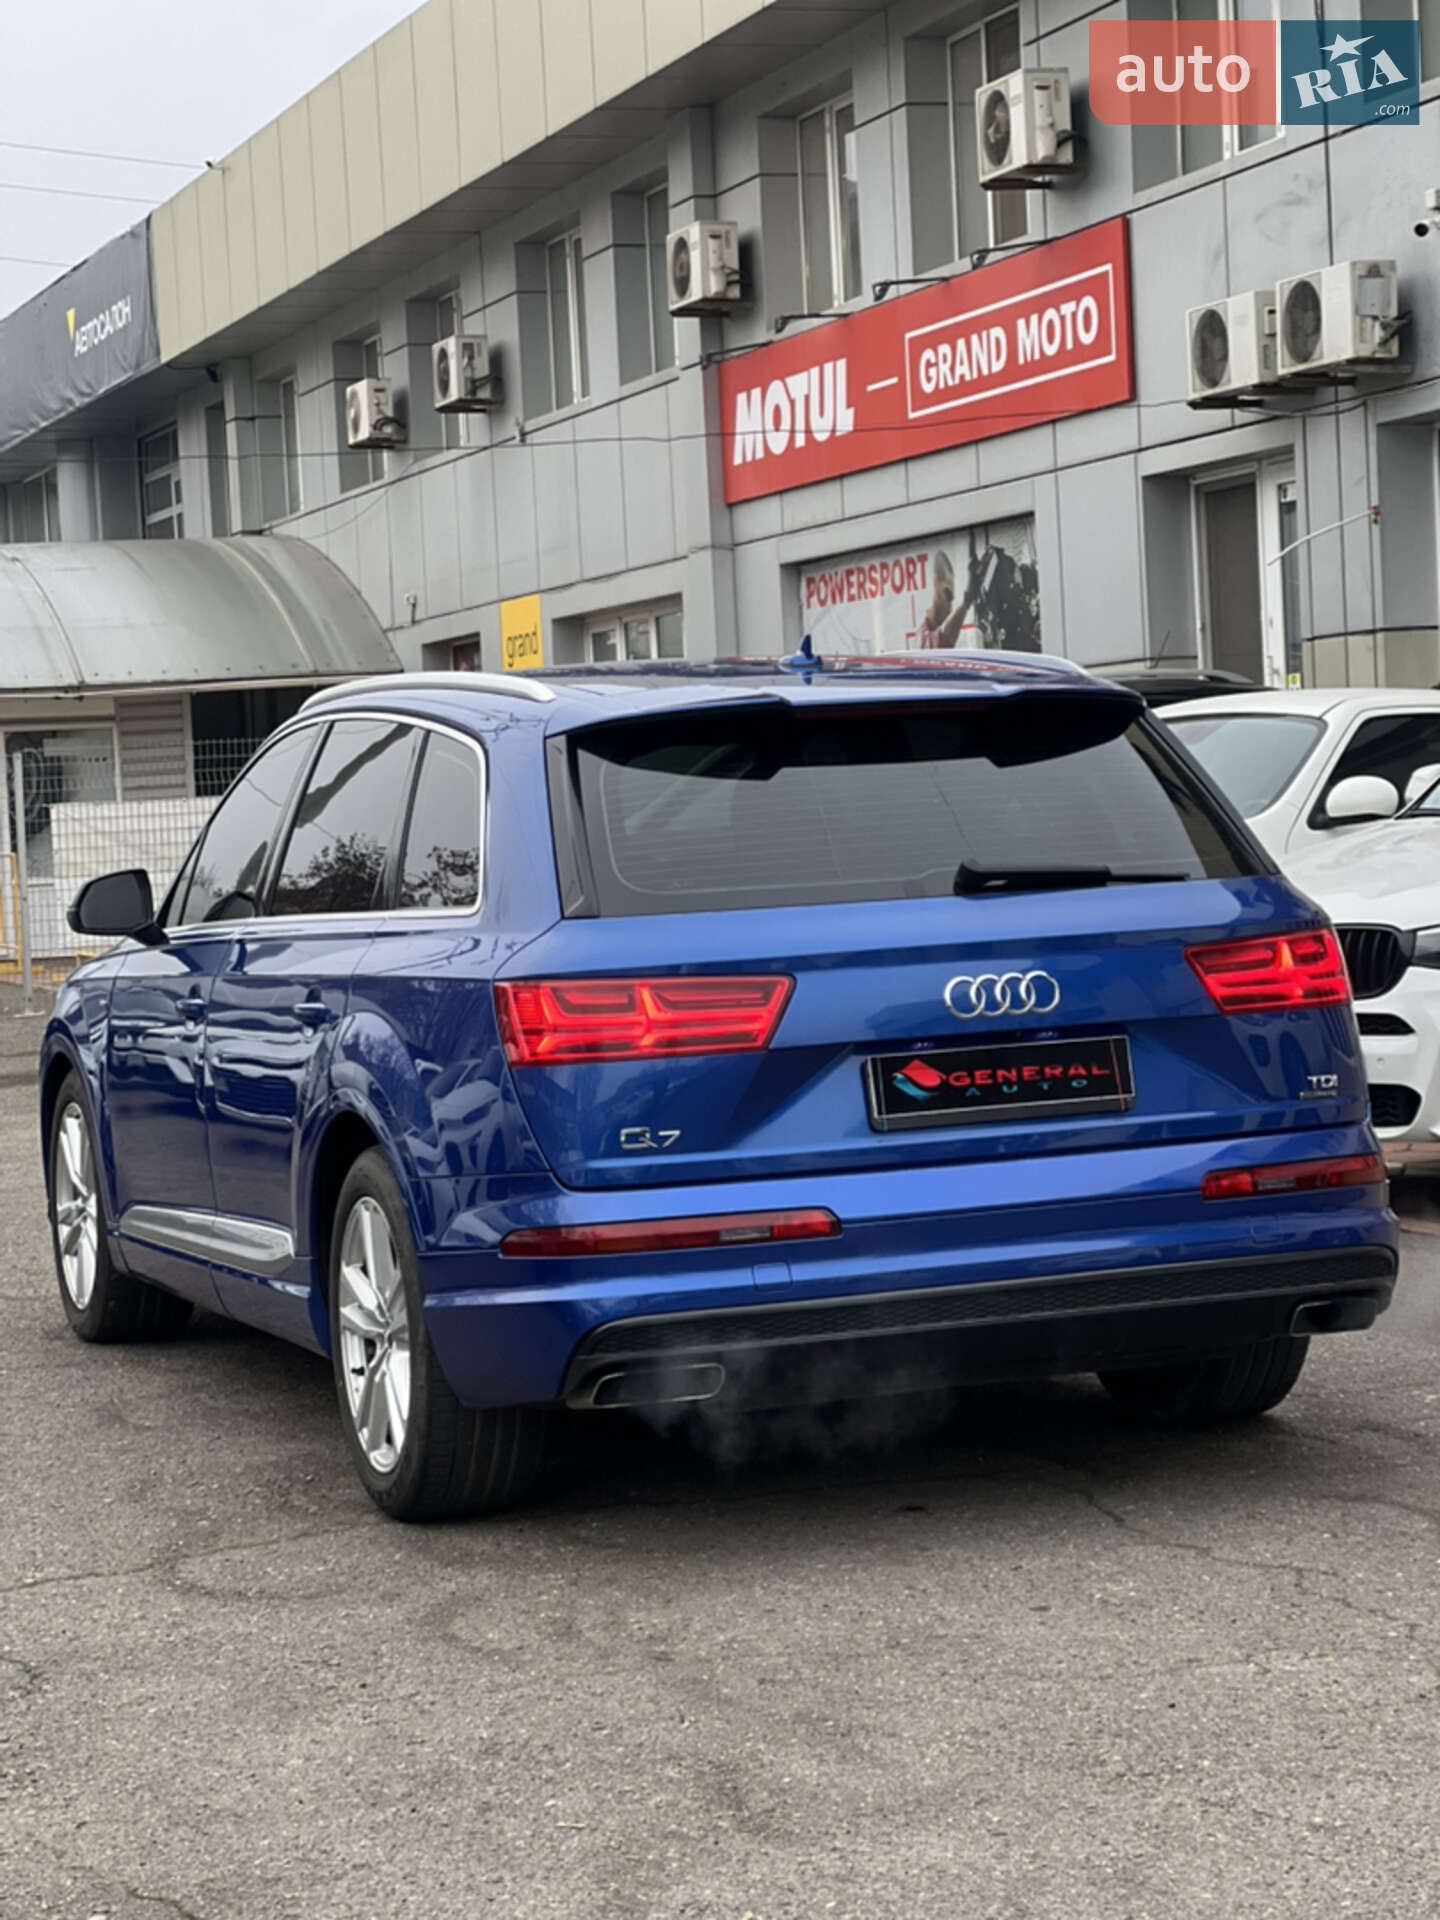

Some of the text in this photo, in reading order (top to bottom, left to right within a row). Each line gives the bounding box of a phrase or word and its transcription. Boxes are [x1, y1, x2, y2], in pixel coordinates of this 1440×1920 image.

[74, 296, 132, 357] АВТОСАЛОН
[733, 295, 1098, 466] MOTUL GRAND MOTO
[806, 554, 928, 608] POWERSPORT
[506, 624, 540, 668] grand
[949, 1064, 1110, 1087] GENERAL
[965, 1079, 1088, 1097] AUTO
[1307, 1074, 1338, 1089] TDI
[620, 1127, 681, 1149] Q7
